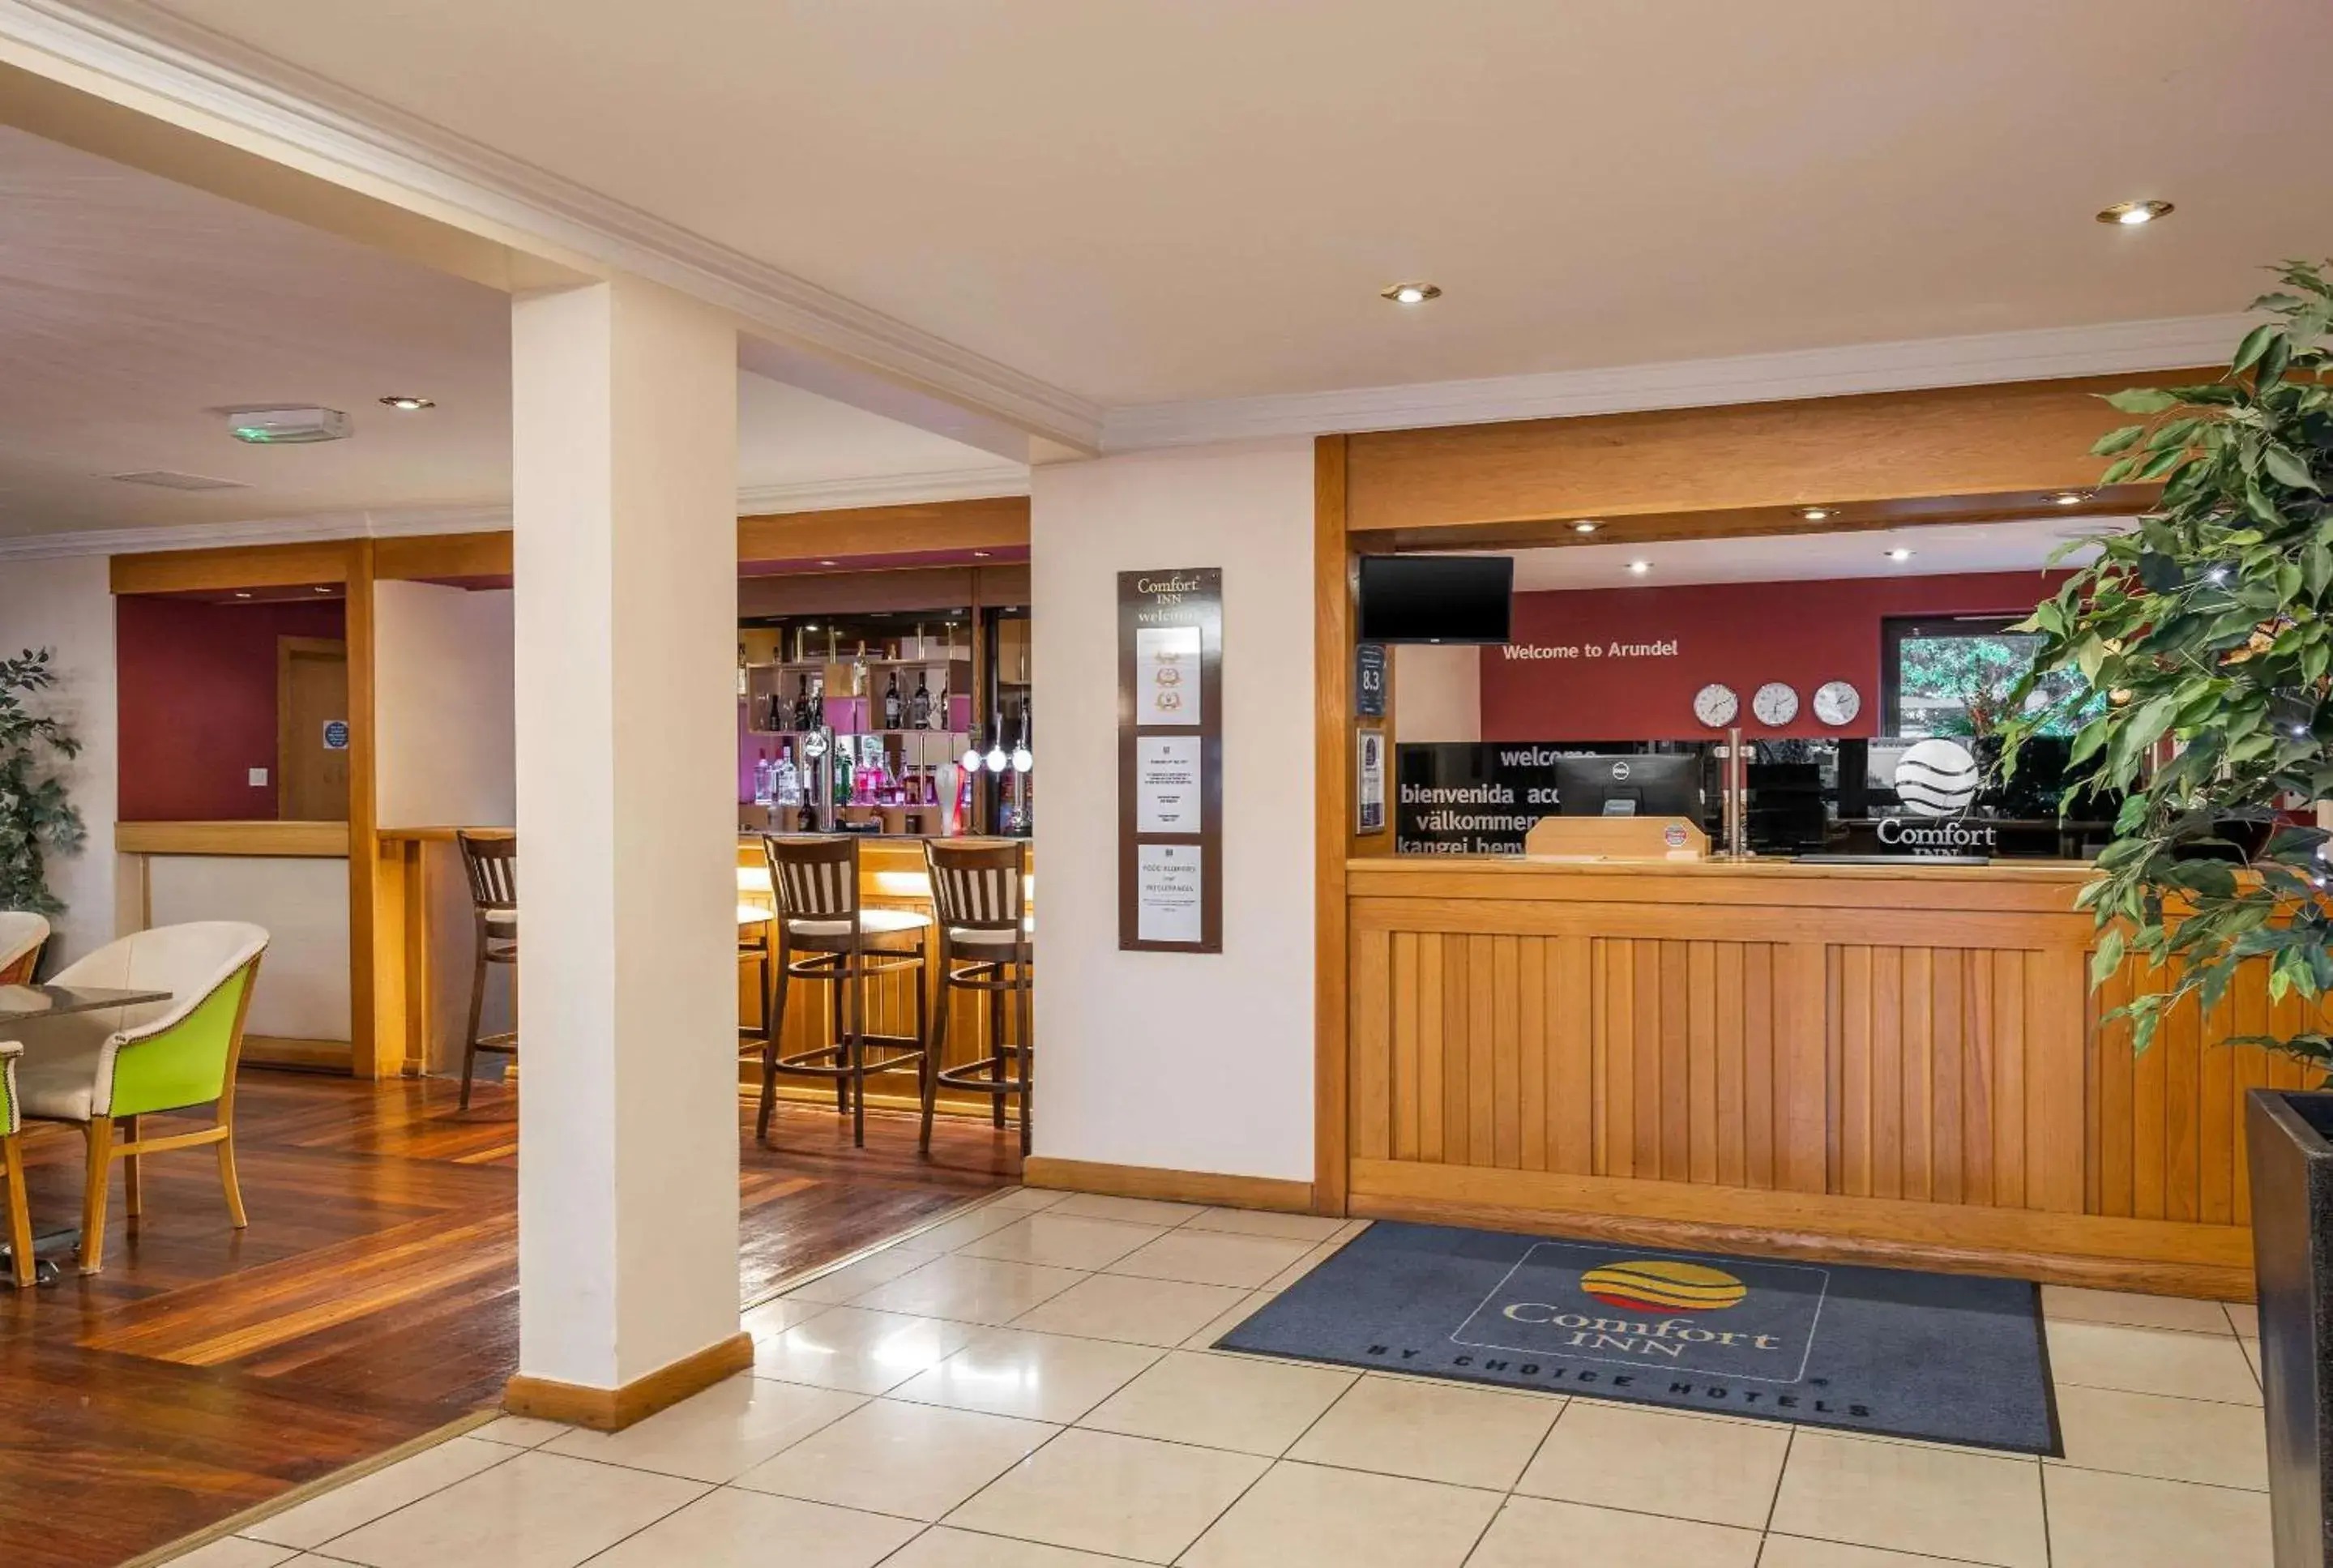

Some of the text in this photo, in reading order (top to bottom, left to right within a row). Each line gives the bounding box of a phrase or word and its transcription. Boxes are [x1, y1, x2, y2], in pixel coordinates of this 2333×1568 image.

[1138, 577, 1201, 593] Comfort
[1156, 593, 1183, 605] INN
[1502, 639, 1679, 660] Welcome to Arundel
[1500, 746, 1596, 767] welco
[1400, 784, 1515, 804] bienvenida
[1877, 818, 1998, 845] Comfort
[1503, 1303, 1780, 1349] Comfort
[1564, 1331, 1686, 1357] INN
[1366, 1344, 1869, 1416] BY CHOICE HOTELS
